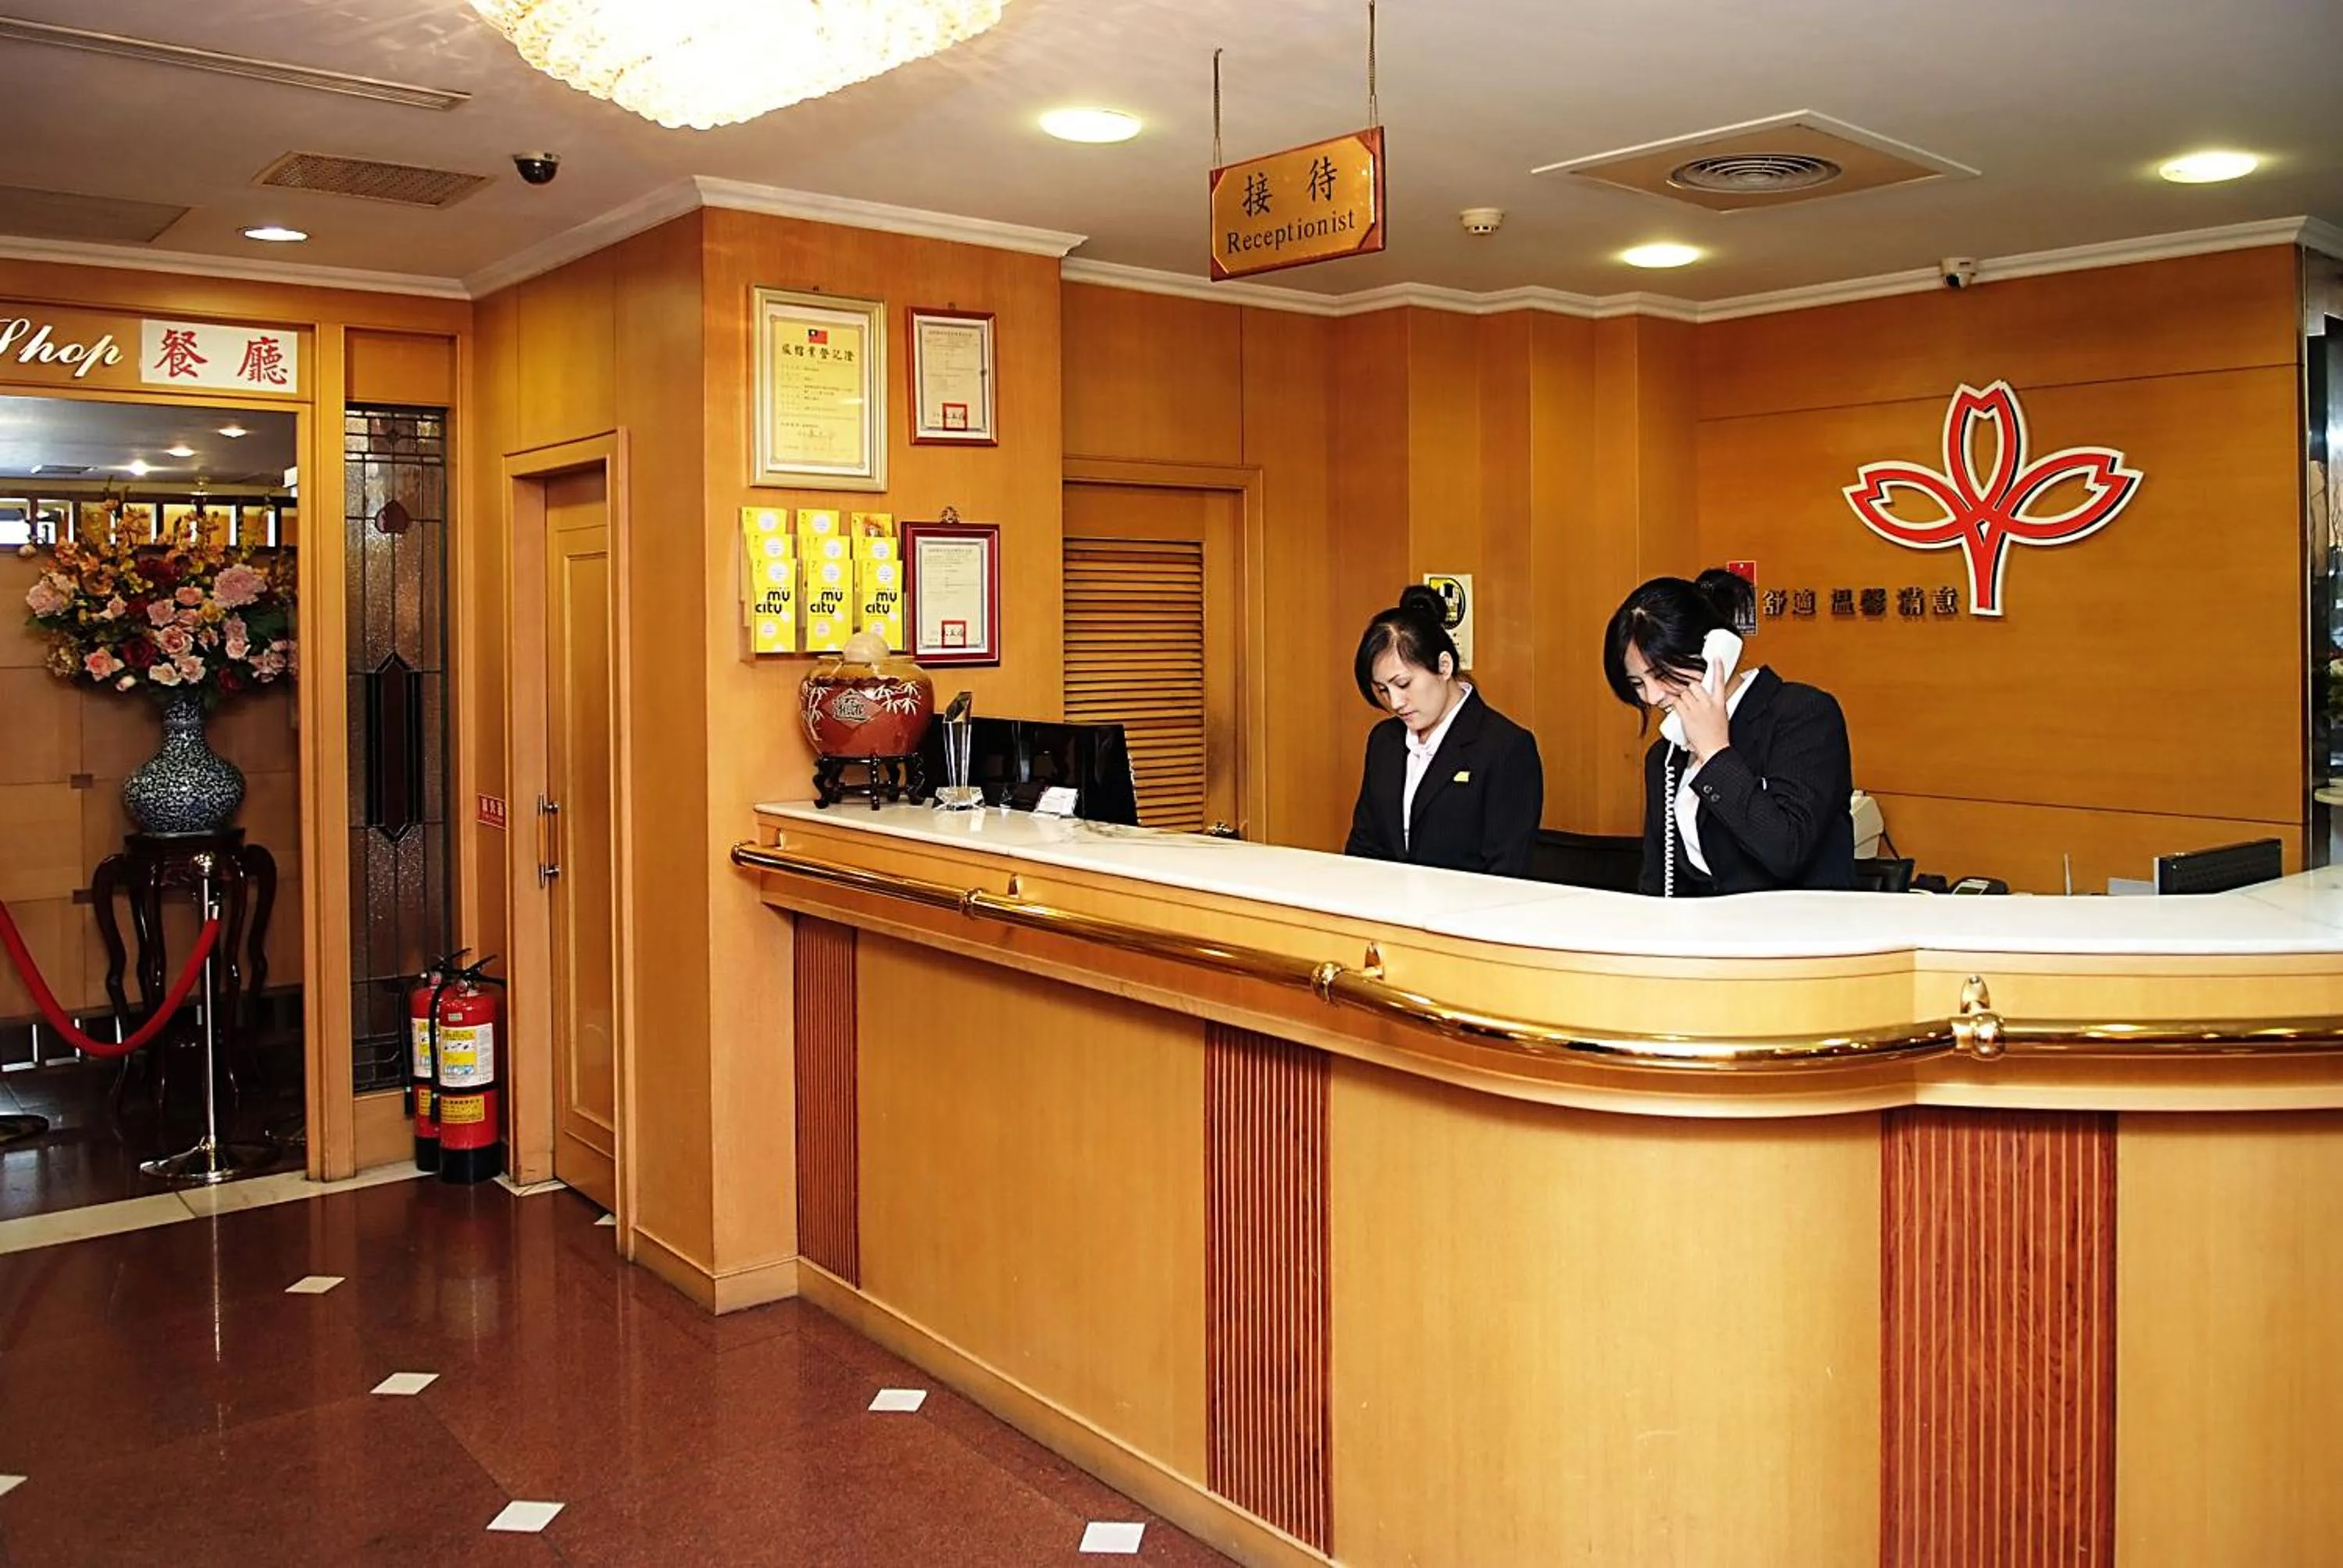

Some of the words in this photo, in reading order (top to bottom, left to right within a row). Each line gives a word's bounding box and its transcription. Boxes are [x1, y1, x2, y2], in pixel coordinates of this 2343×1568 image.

[1242, 155, 1338, 218] 接待
[1226, 208, 1356, 255] Receptionist
[153, 328, 289, 386] 餐廳
[754, 602, 783, 614] city
[810, 603, 835, 615] city
[865, 604, 890, 615] city
[1762, 587, 1816, 616] 舒適
